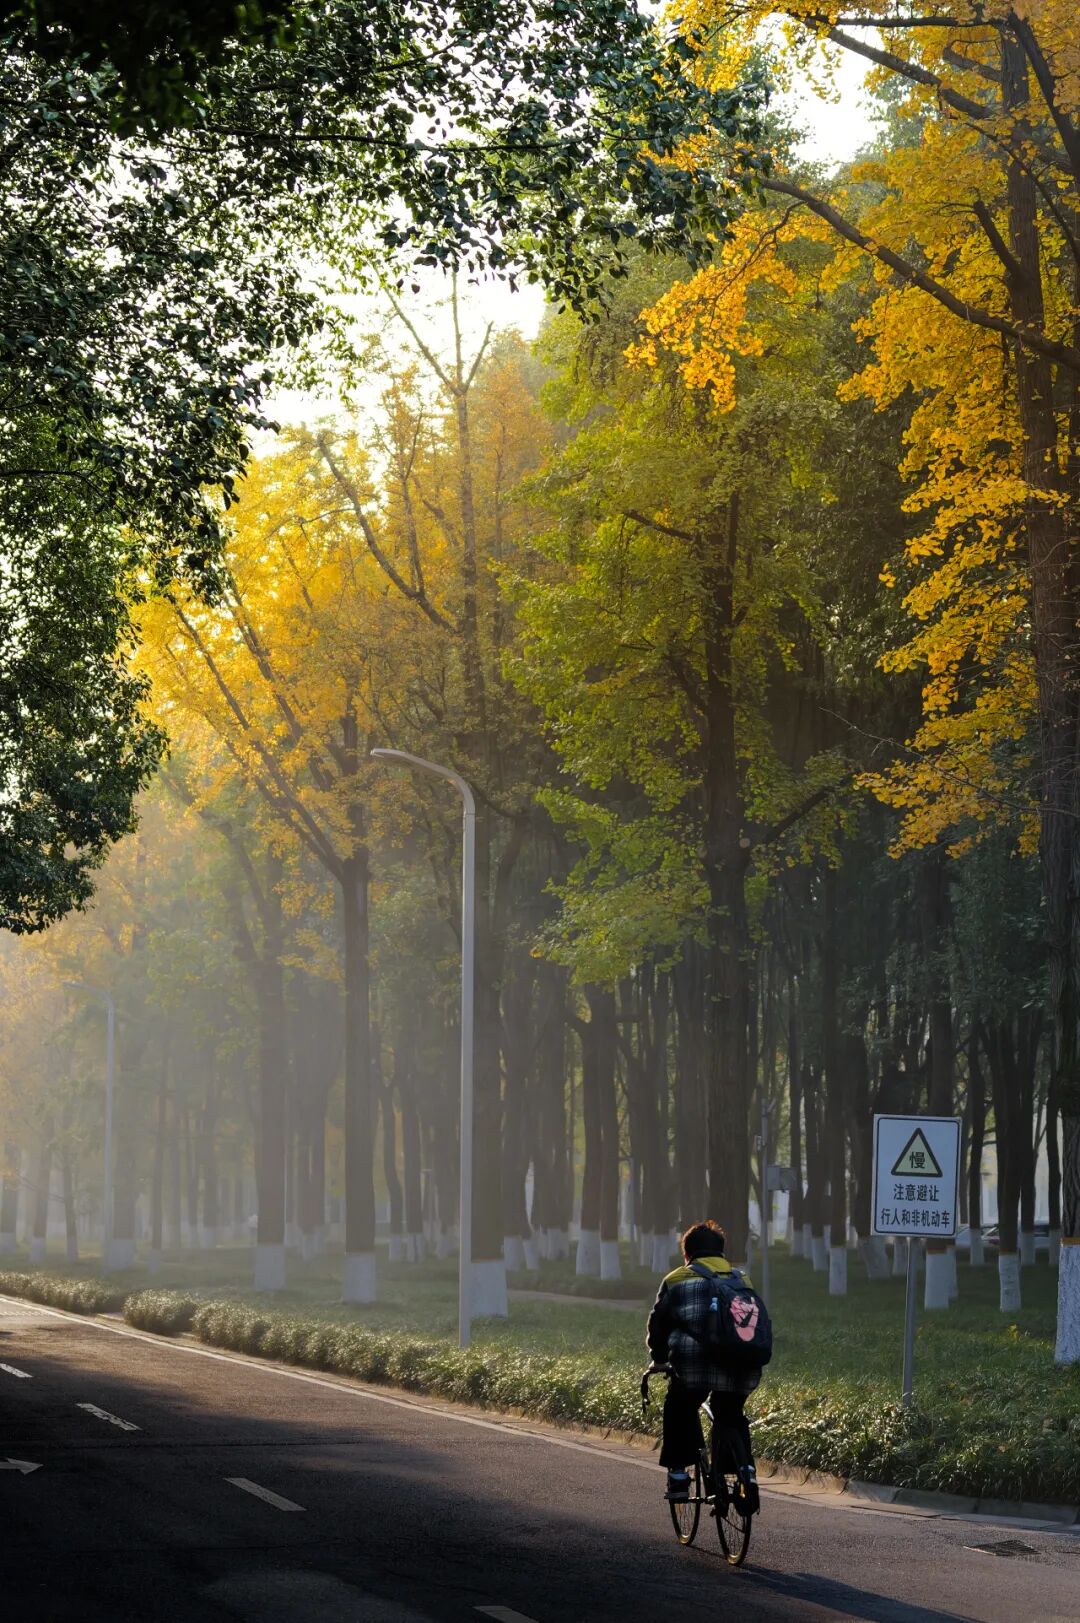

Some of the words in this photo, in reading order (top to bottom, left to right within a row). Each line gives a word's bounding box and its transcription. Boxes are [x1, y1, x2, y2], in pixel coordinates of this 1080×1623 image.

[909, 1151, 926, 1169] 慢
[893, 1184, 940, 1202] 注意避让
[881, 1208, 950, 1228] 行人和非机动车
